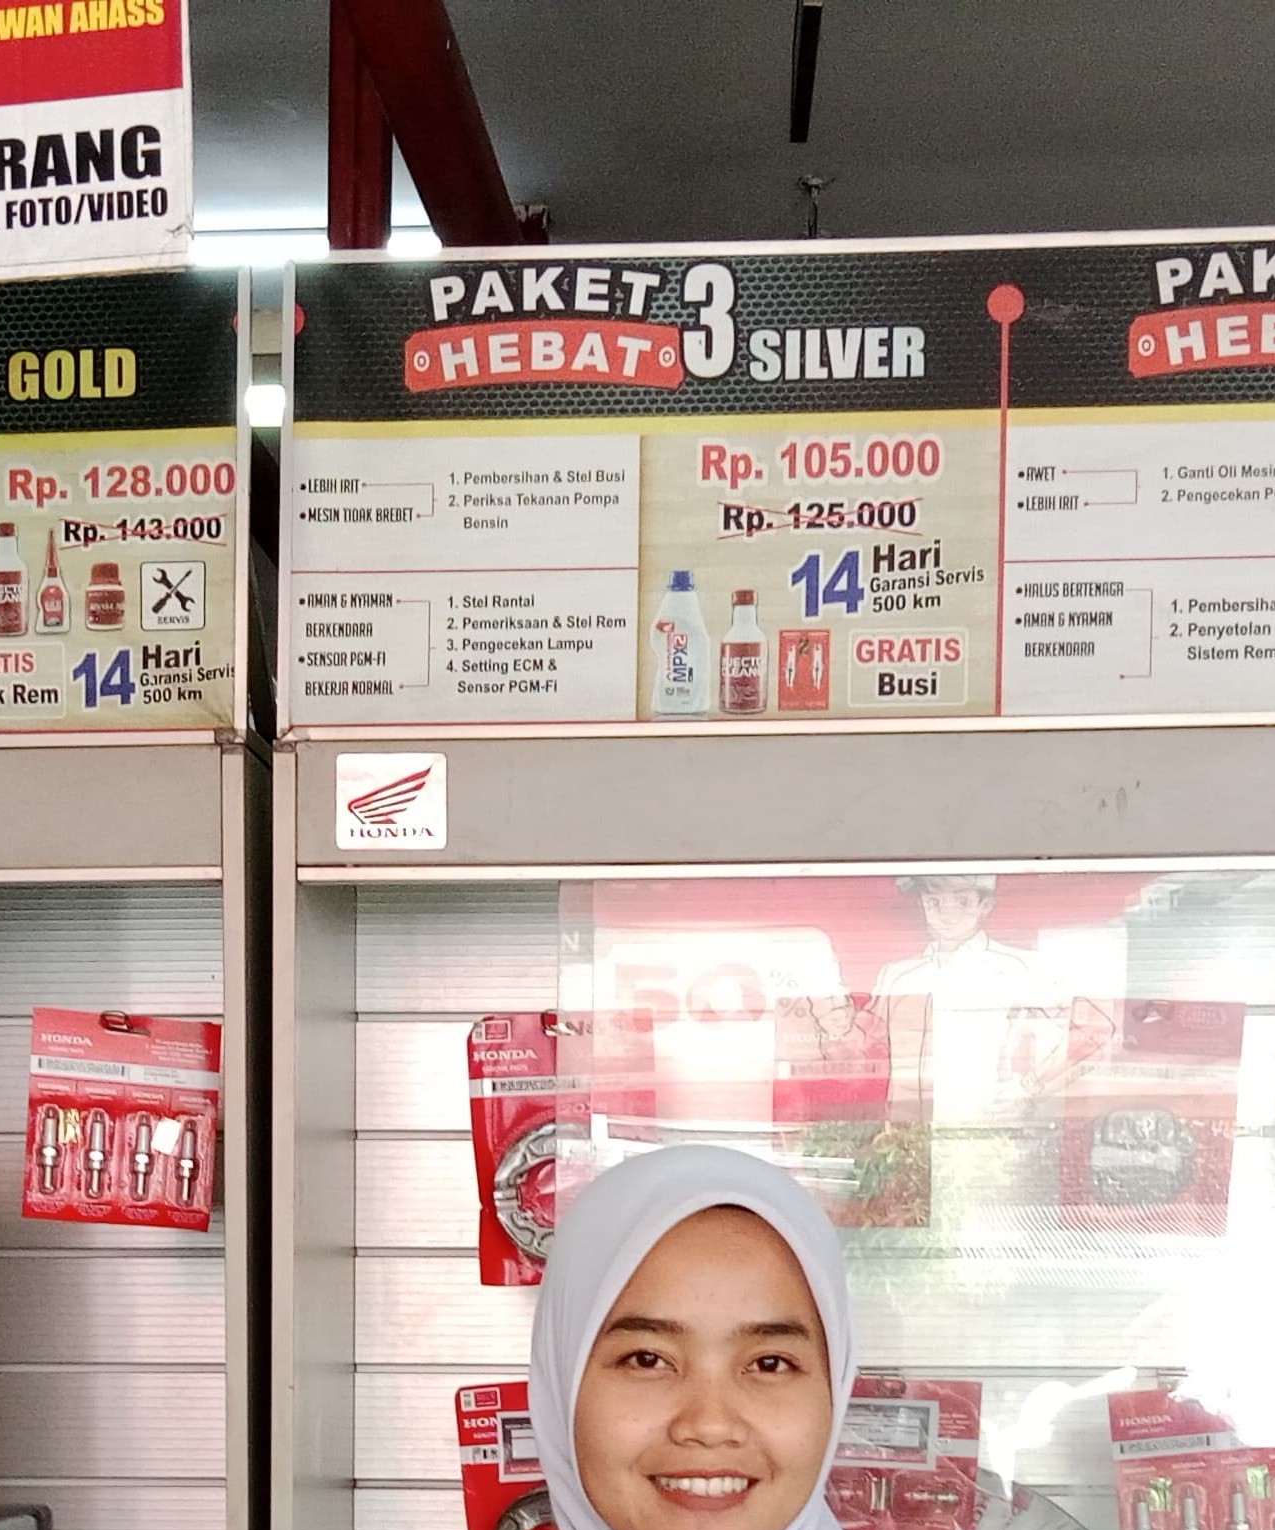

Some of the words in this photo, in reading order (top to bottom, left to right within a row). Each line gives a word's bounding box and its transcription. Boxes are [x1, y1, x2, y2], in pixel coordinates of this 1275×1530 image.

[70, 0, 165, 34] AHASS
[5, 187, 168, 230] FOTO/VIDEO
[429, 267, 661, 321] PAKET
[683, 264, 735, 378] 3
[440, 331, 652, 381] HEBAT
[748, 327, 925, 379] SILVER
[8, 348, 137, 400] GOLD
[701, 445, 763, 489] Rp.
[780, 440, 940, 478] 105.000
[464, 470, 549, 485] Pembersihan
[567, 470, 592, 483] Stel
[596, 469, 625, 482] Busi
[1027, 467, 1056, 481] AWET
[1177, 466, 1214, 479] Ganti
[1218, 466, 1237, 479] Oli
[9, 469, 68, 507] Rp.
[84, 463, 235, 498] 128.000
[340, 479, 359, 493] IRIT
[464, 493, 511, 507] Periksa
[517, 493, 570, 507] Tekanan
[575, 492, 619, 507] Pompa
[1177, 488, 1260, 502] Pengecekan
[1026, 496, 1056, 510] LEBIH
[1059, 496, 1078, 510] IRIT
[308, 508, 340, 522] MESIN
[464, 516, 508, 529] Bensin
[723, 504, 773, 536] Rp.
[787, 501, 916, 528] 125.000
[64, 520, 105, 546] Rp.
[116, 517, 221, 540] 143.000
[791, 551, 865, 617] 14
[873, 540, 941, 573] Hari
[870, 575, 930, 593] Garansi
[936, 566, 984, 586] Servis
[1024, 583, 1059, 597] HALUS
[1063, 582, 1123, 597] BERTENAGA
[463, 596, 487, 609] Stel
[493, 595, 534, 608] Rantai
[873, 595, 906, 612] 500
[913, 593, 941, 609] km
[463, 617, 548, 630] Pemeriksaan
[567, 616, 592, 628] Stel
[597, 616, 626, 628] Rem
[1024, 613, 1054, 627] AMAN
[1069, 612, 1113, 626] NYAMAN
[1188, 623, 1271, 637] Penyetelan
[462, 638, 543, 654] Pengecekan
[548, 637, 593, 652] Lampu
[856, 639, 961, 662] GRATIS
[1187, 646, 1239, 660] Sistem
[307, 652, 347, 666] SENSOR
[462, 659, 508, 674] Setting
[514, 659, 543, 672] ECM
[72, 650, 135, 708] 14
[142, 641, 201, 669] Hari
[140, 670, 192, 687] Garansi
[352, 680, 393, 695] NORMAL
[457, 681, 504, 694] Sensor
[878, 673, 937, 696] Busi
[13, 684, 59, 704] Rem
[143, 689, 170, 703] 500
[177, 687, 202, 701] km
[349, 827, 435, 837] HONDA
[41, 1033, 93, 1046] HONDA
[473, 1049, 537, 1062] HONDA
[1120, 1415, 1173, 1426] HONDA
